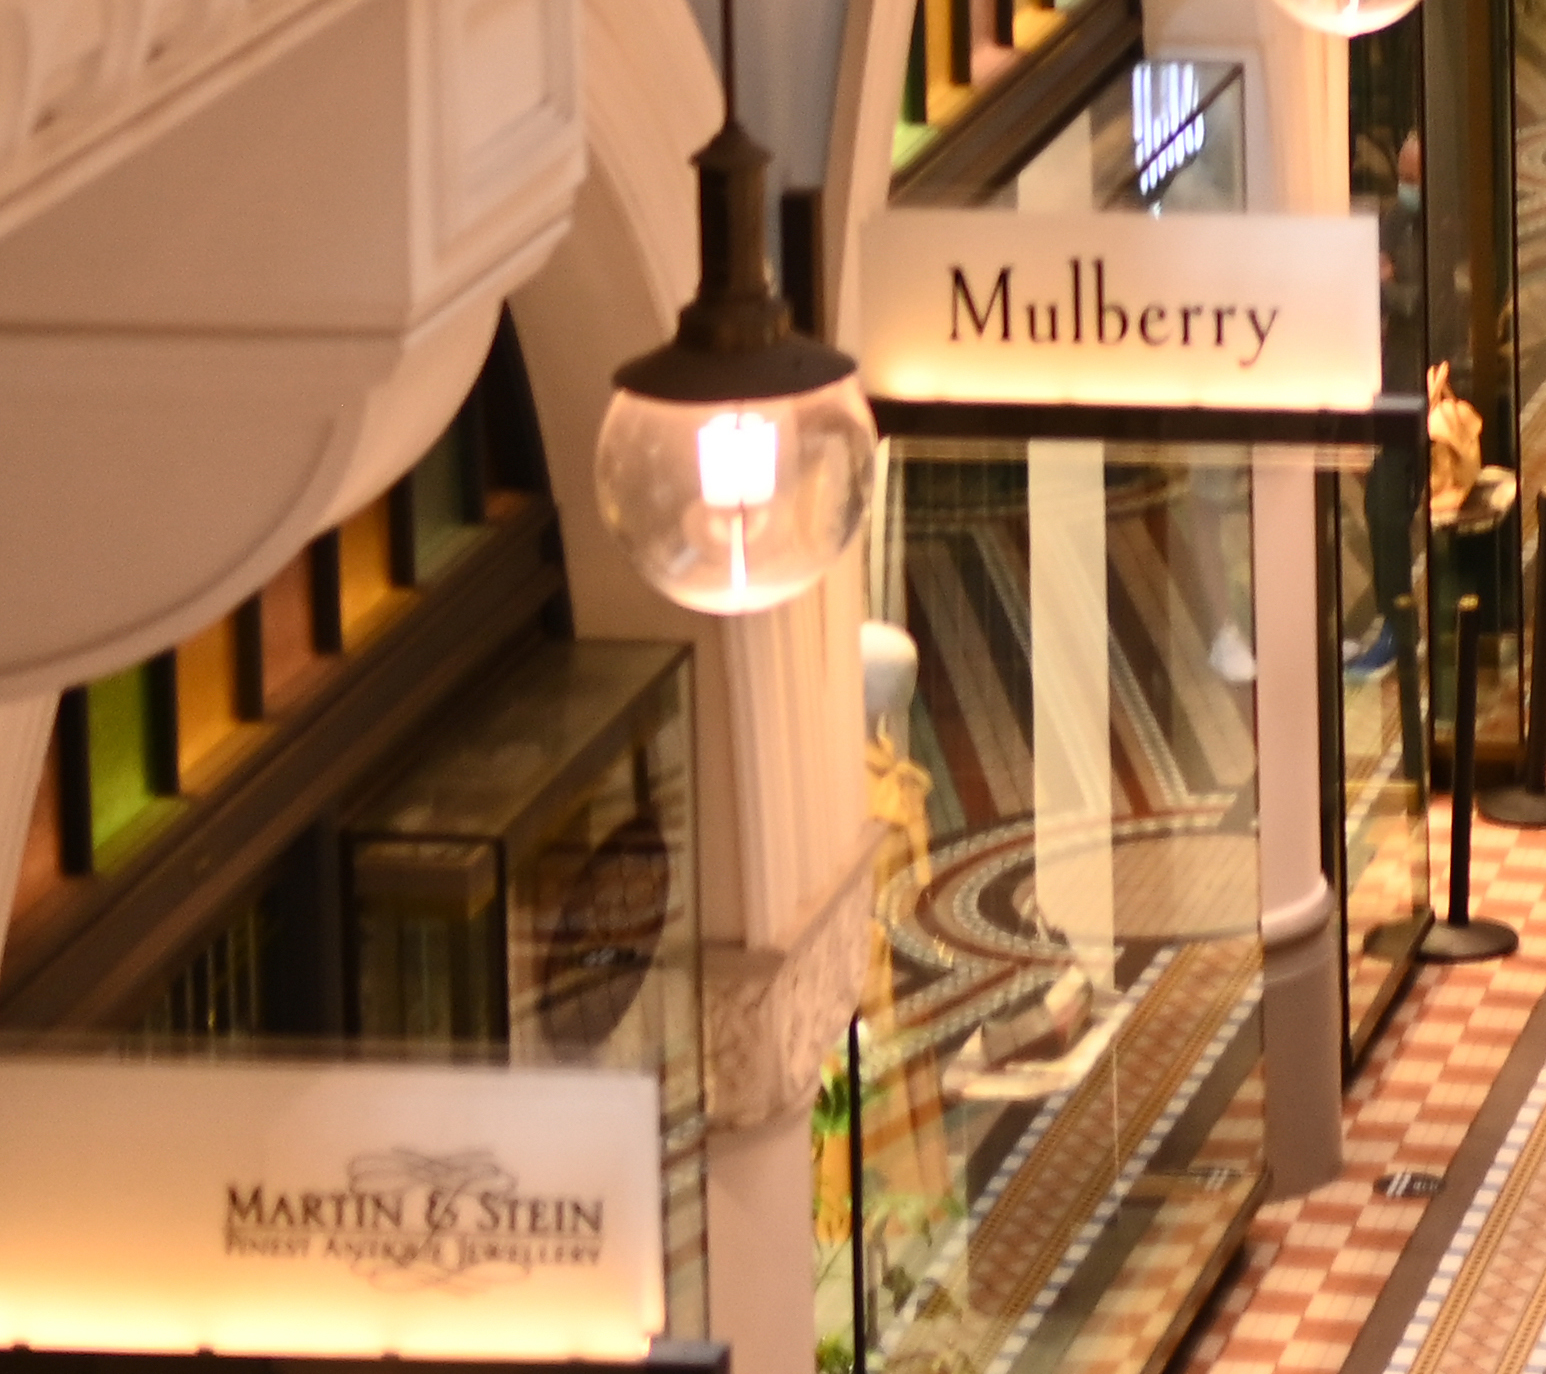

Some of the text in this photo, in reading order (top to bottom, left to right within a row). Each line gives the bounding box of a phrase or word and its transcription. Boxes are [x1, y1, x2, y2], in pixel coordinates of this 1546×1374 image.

[949, 256, 1279, 369] Mulberry
[226, 1183, 402, 1229] MARTIN
[479, 1191, 604, 1234] STEIN
